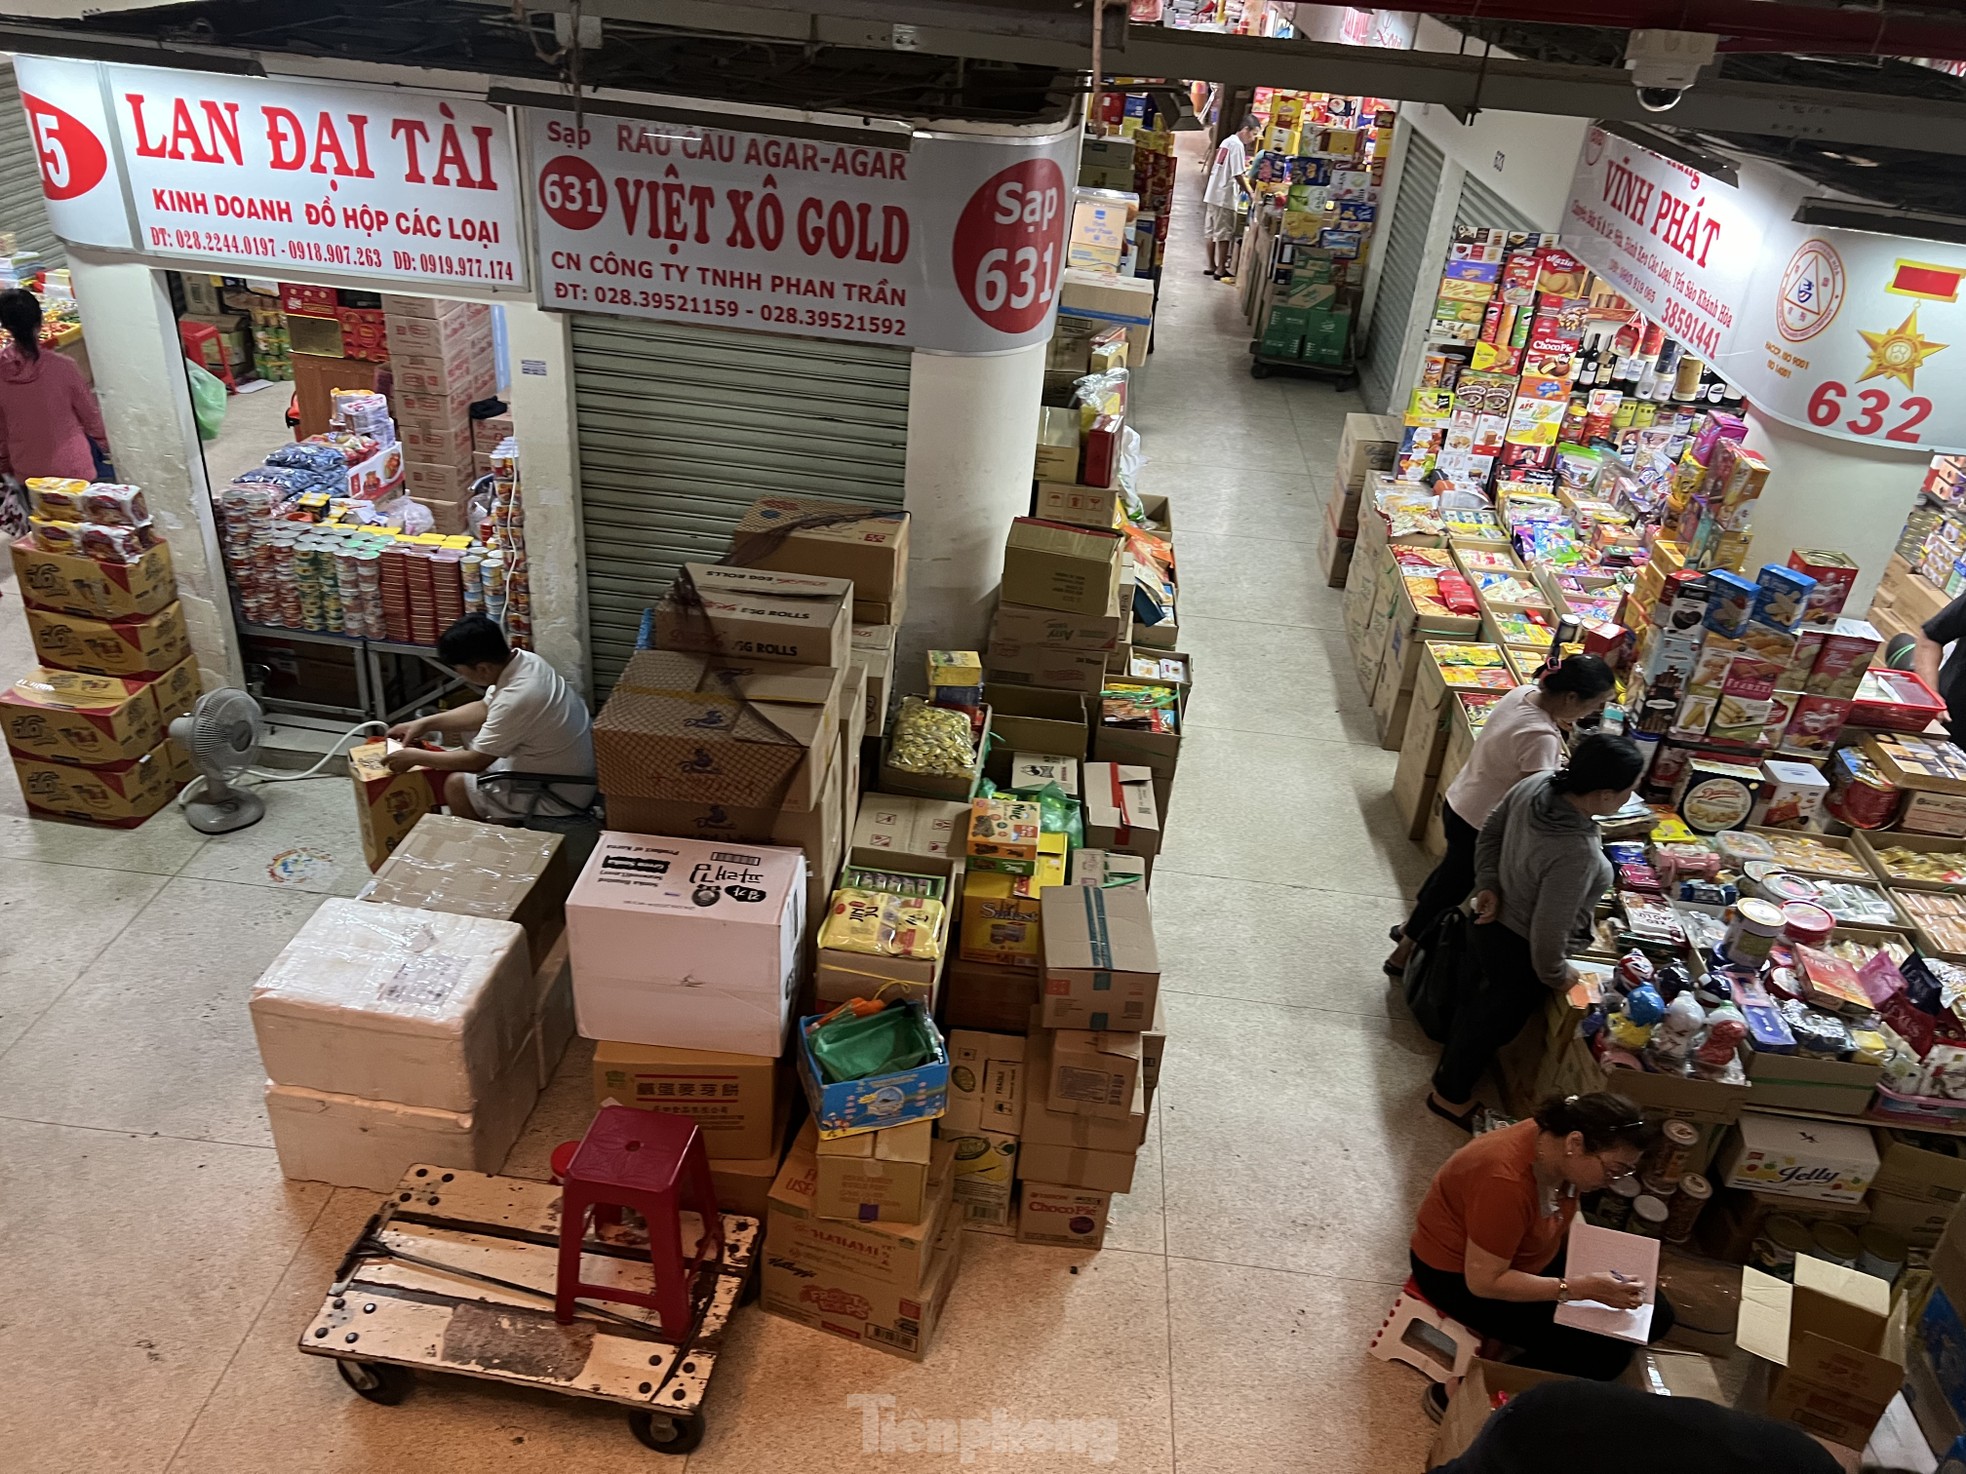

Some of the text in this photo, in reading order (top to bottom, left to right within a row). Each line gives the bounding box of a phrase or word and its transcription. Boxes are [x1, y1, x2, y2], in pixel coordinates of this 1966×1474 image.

[125, 93, 498, 192] LAN ĐẠI TÀI
[547, 121, 591, 150] Sạp
[745, 140, 907, 181] AGAR-AGAR
[152, 188, 500, 250] KINH DOANH ĐỒ HỘP CÁC LOẠI
[545, 172, 605, 214] 631
[614, 163, 910, 264] VIỆT XÔ GOLD
[992, 180, 1058, 232] Sạp
[1602, 156, 1655, 227] VĨNH
[1650, 196, 1721, 268] PHÁT
[176, 227, 276, 259] 028.2244.0197
[288, 239, 382, 268] 0918.907.263
[419, 251, 513, 281] 0919.977.174
[551, 251, 906, 306] CN CÔNG TY TNHH PHAN TRẦN
[974, 242, 1056, 312] 631
[554, 282, 587, 300] ĐT:
[595, 286, 739, 317] 028.39521159
[760, 304, 906, 336] 028.39521592
[1661, 296, 1721, 360] 38591441
[1807, 380, 1933, 444] 632
[768, 609, 810, 620] ROLLS
[757, 642, 798, 657] ROLLS
[689, 863, 764, 884] 파래김
[1767, 1166, 1841, 1184] Jelly
